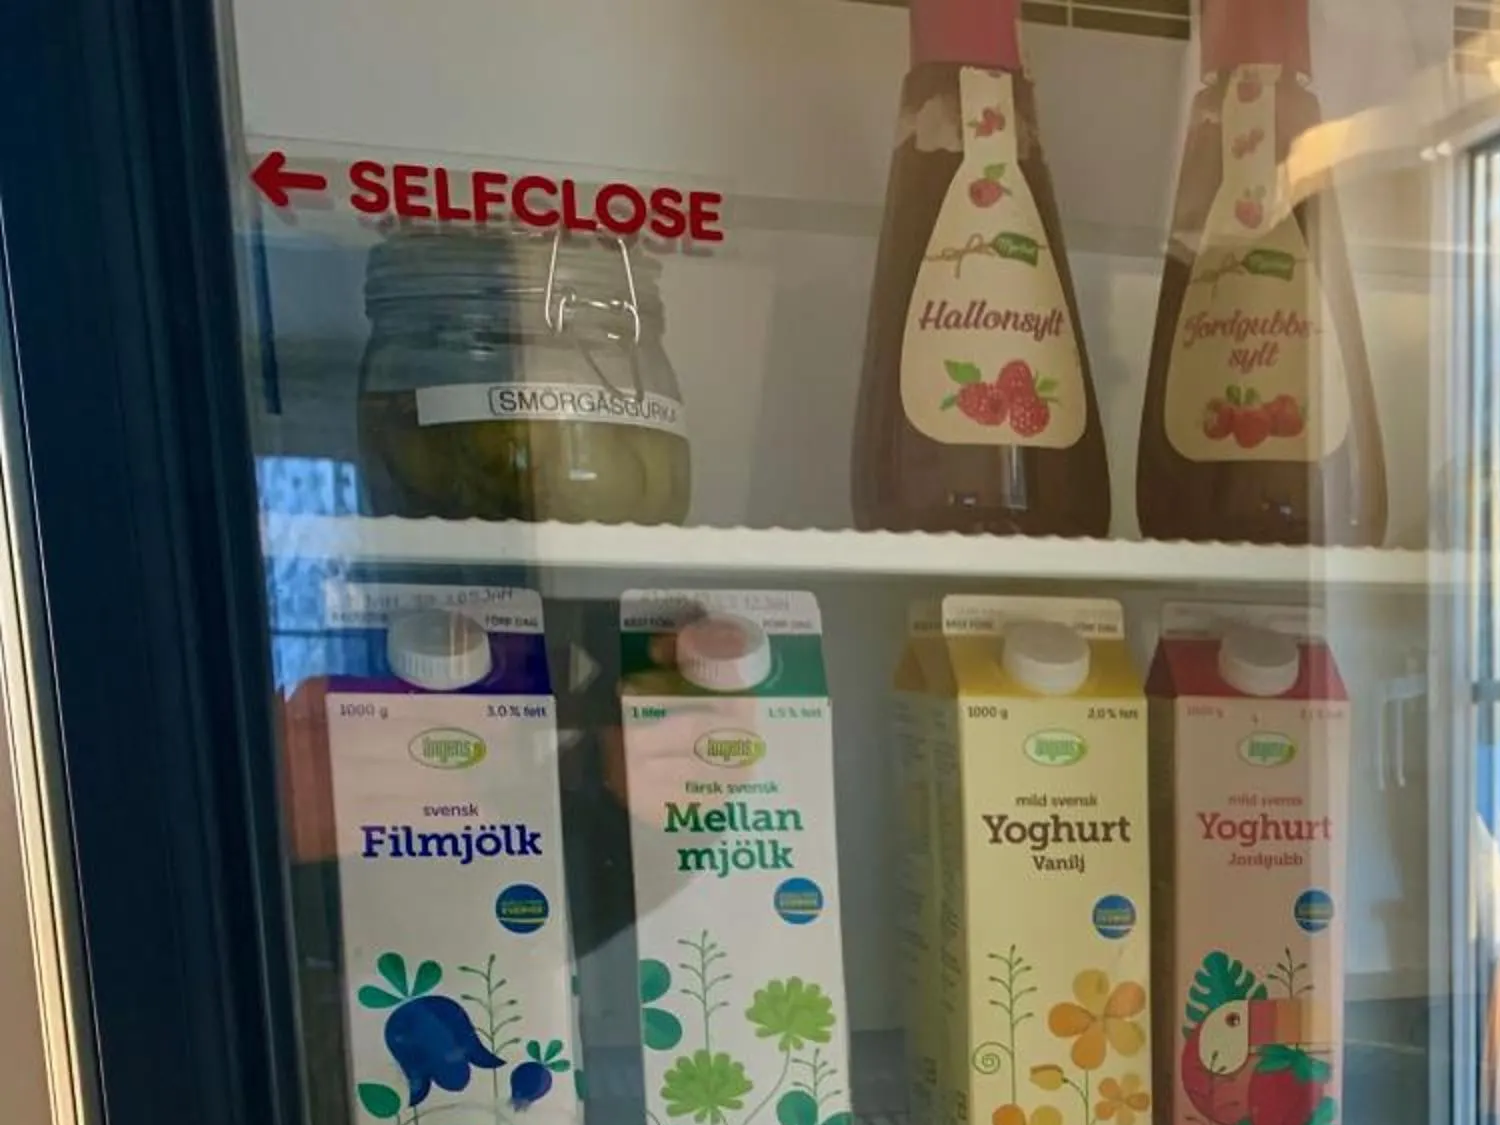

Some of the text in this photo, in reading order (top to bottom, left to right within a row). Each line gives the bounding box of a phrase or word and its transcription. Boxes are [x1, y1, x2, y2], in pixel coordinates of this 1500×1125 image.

[349, 160, 724, 242] SELFCLOSE
[918, 300, 1067, 340] Hallonsylt
[1228, 341, 1279, 375] sylt
[726, 780, 779, 796] svensk
[423, 803, 479, 818] svensk
[664, 801, 804, 832] Mellan
[361, 825, 542, 865] Filmjölk
[982, 813, 1132, 851] Yoghurt
[1197, 812, 1333, 847] Yoghurt
[677, 839, 795, 877] mjölk
[1033, 854, 1086, 874] Vanilj
